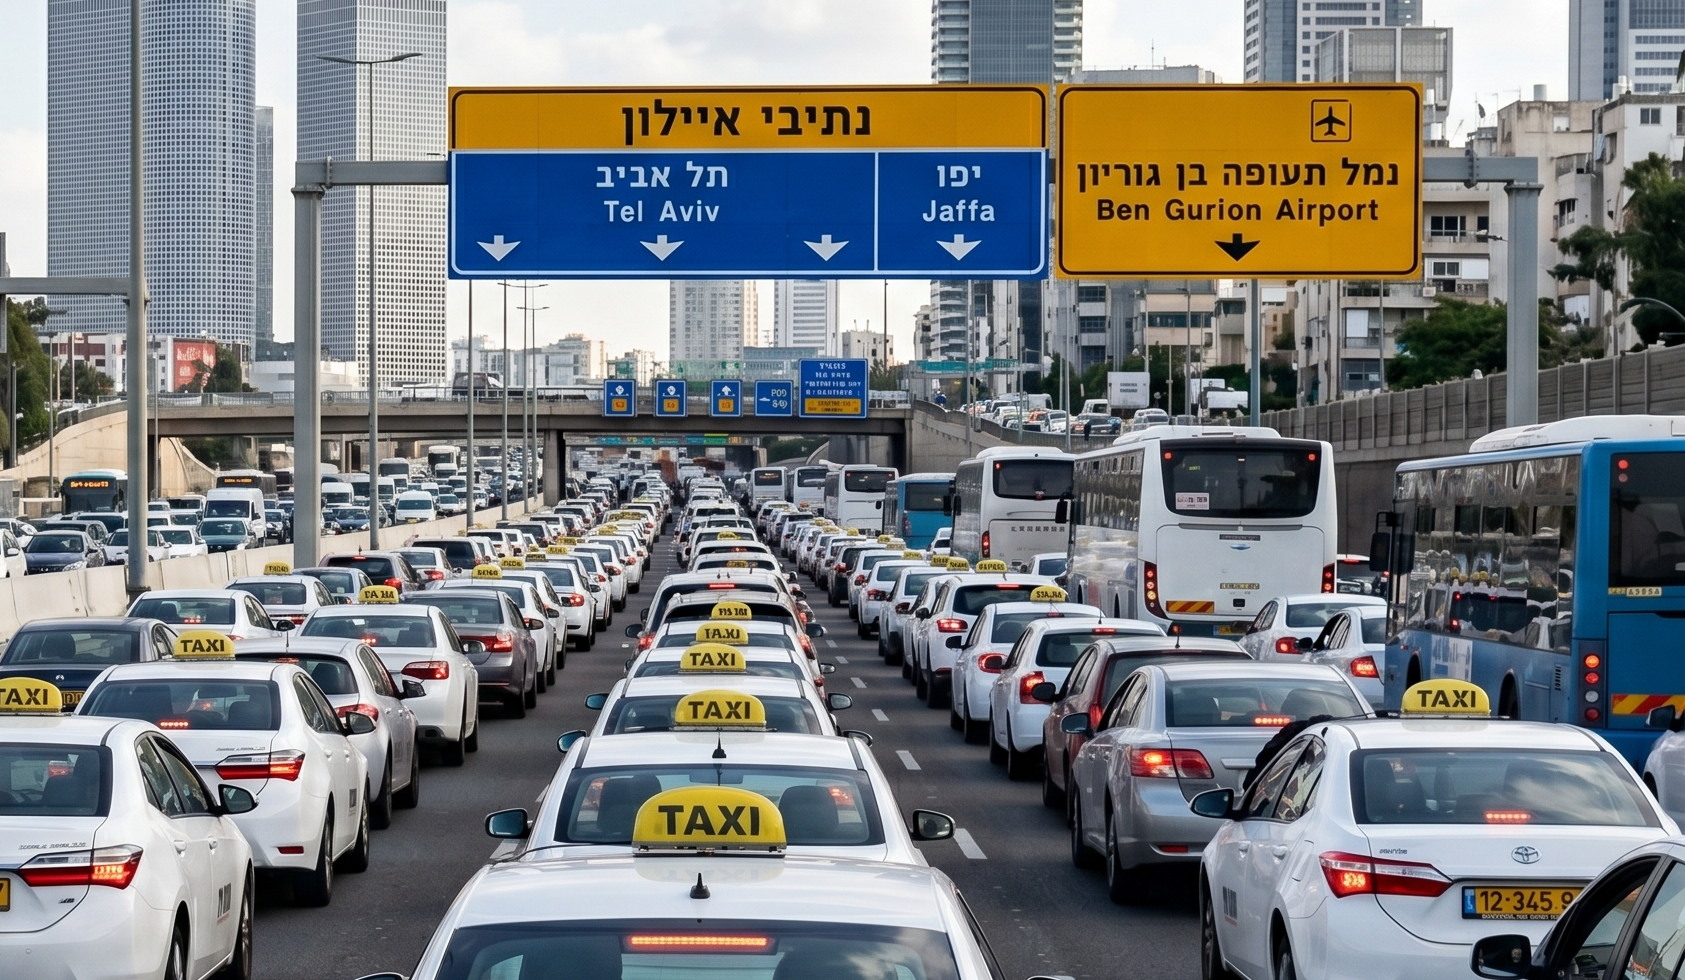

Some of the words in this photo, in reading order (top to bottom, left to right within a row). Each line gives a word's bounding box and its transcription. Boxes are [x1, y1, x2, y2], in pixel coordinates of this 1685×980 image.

[622, 99, 740, 146] איילון
[761, 106, 871, 136] נתיבי
[596, 166, 671, 188] אביב
[687, 161, 728, 188] תל
[937, 165, 981, 187] יפו
[1077, 163, 1161, 192] גוריון
[1176, 163, 1207, 191] בן
[1223, 163, 1326, 186] תעופה
[1341, 157, 1399, 186] נמל
[604, 200, 643, 222] Tel
[659, 200, 720, 222] Aviv
[922, 199, 995, 222] Jaffa
[1097, 198, 1150, 221] Ben
[1165, 198, 1262, 221] Gurion
[1276, 197, 1379, 227] Airport
[181, 639, 225, 653] TAXI
[690, 652, 736, 667] TAXI
[688, 700, 750, 720] TAXI
[1417, 689, 1477, 708] TAXI
[658, 805, 760, 836] TAXI
